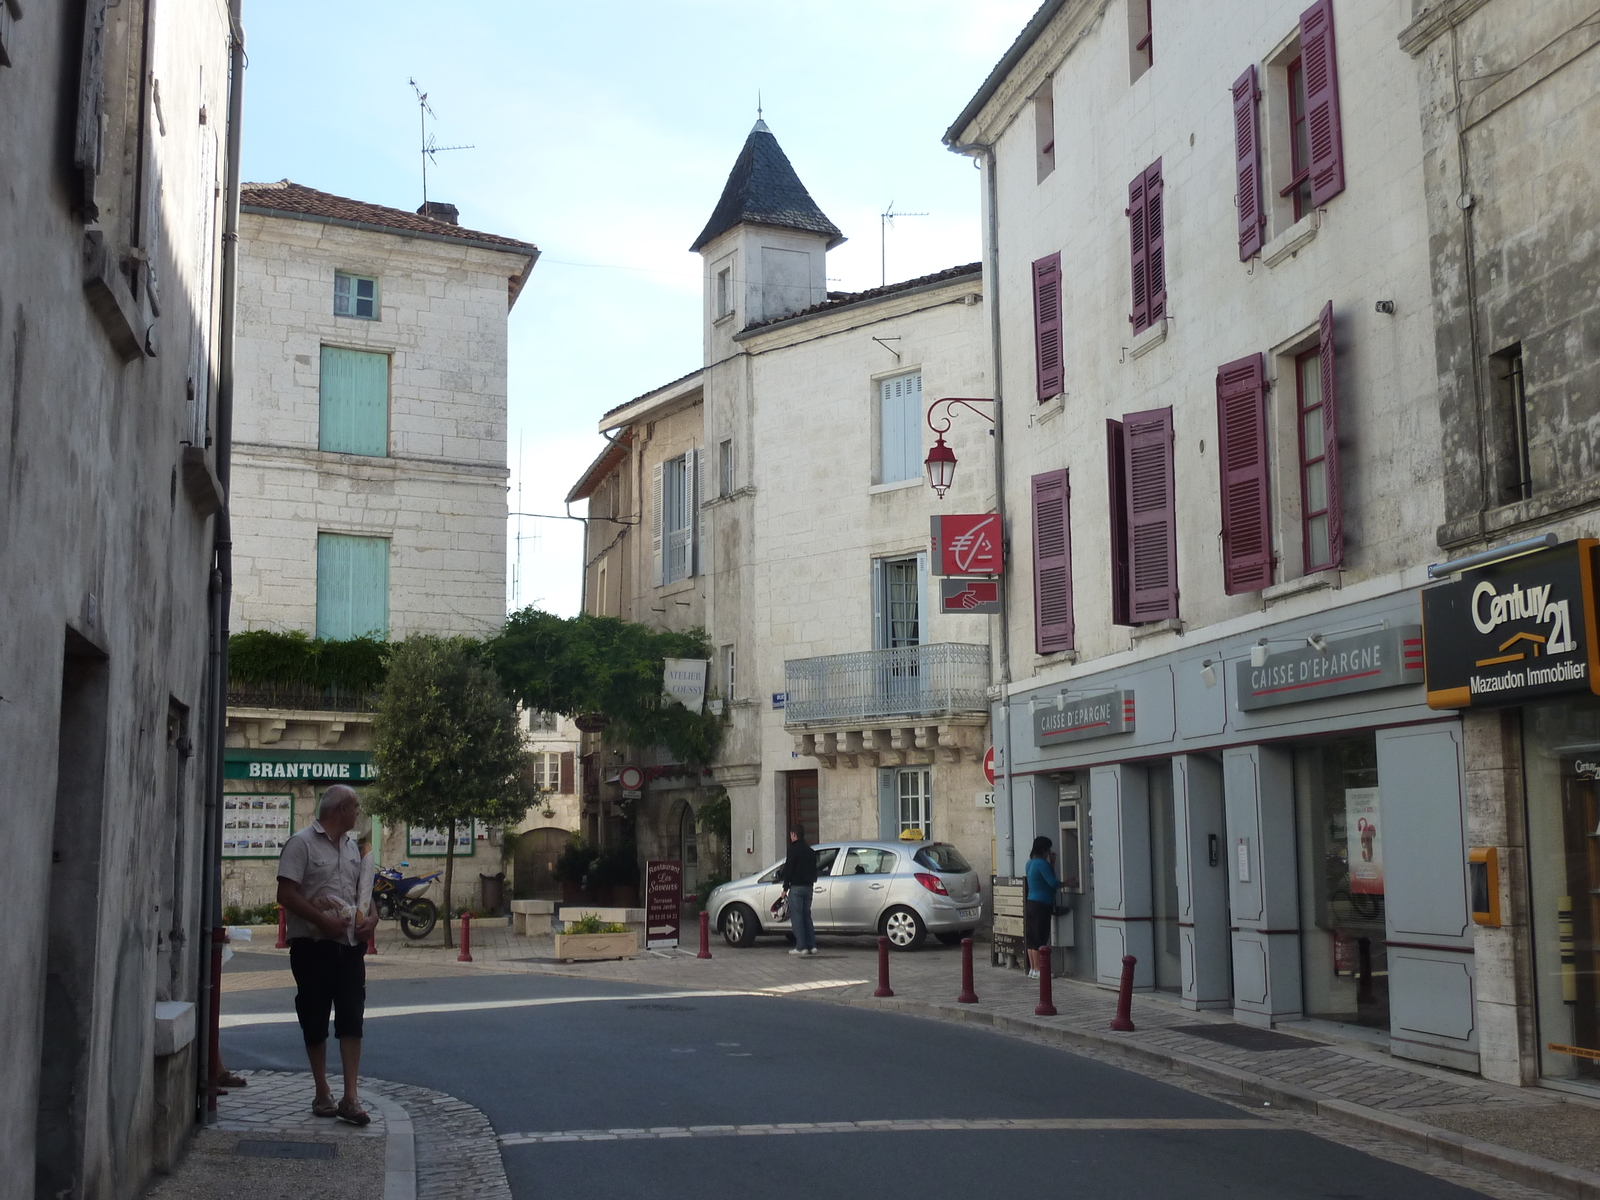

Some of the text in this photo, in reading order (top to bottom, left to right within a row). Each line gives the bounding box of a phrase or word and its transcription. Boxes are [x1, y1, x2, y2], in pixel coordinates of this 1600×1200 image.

[1471, 581, 1572, 655] Century 21
[1251, 645, 1381, 689] CAISSE D'EPARGNE
[669, 671, 701, 681] ATELIER
[1470, 661, 1586, 694] Mazaudon Immobilier
[672, 685, 703, 695] COUSSY
[1041, 703, 1111, 730] CAISSE D'EPARGNE
[249, 762, 378, 778] BRANTOME IM
[1575, 760, 1596, 773] Century
[648, 863, 680, 875] Restaurant
[657, 872, 672, 883] Les
[648, 880, 678, 893] Saveurs
